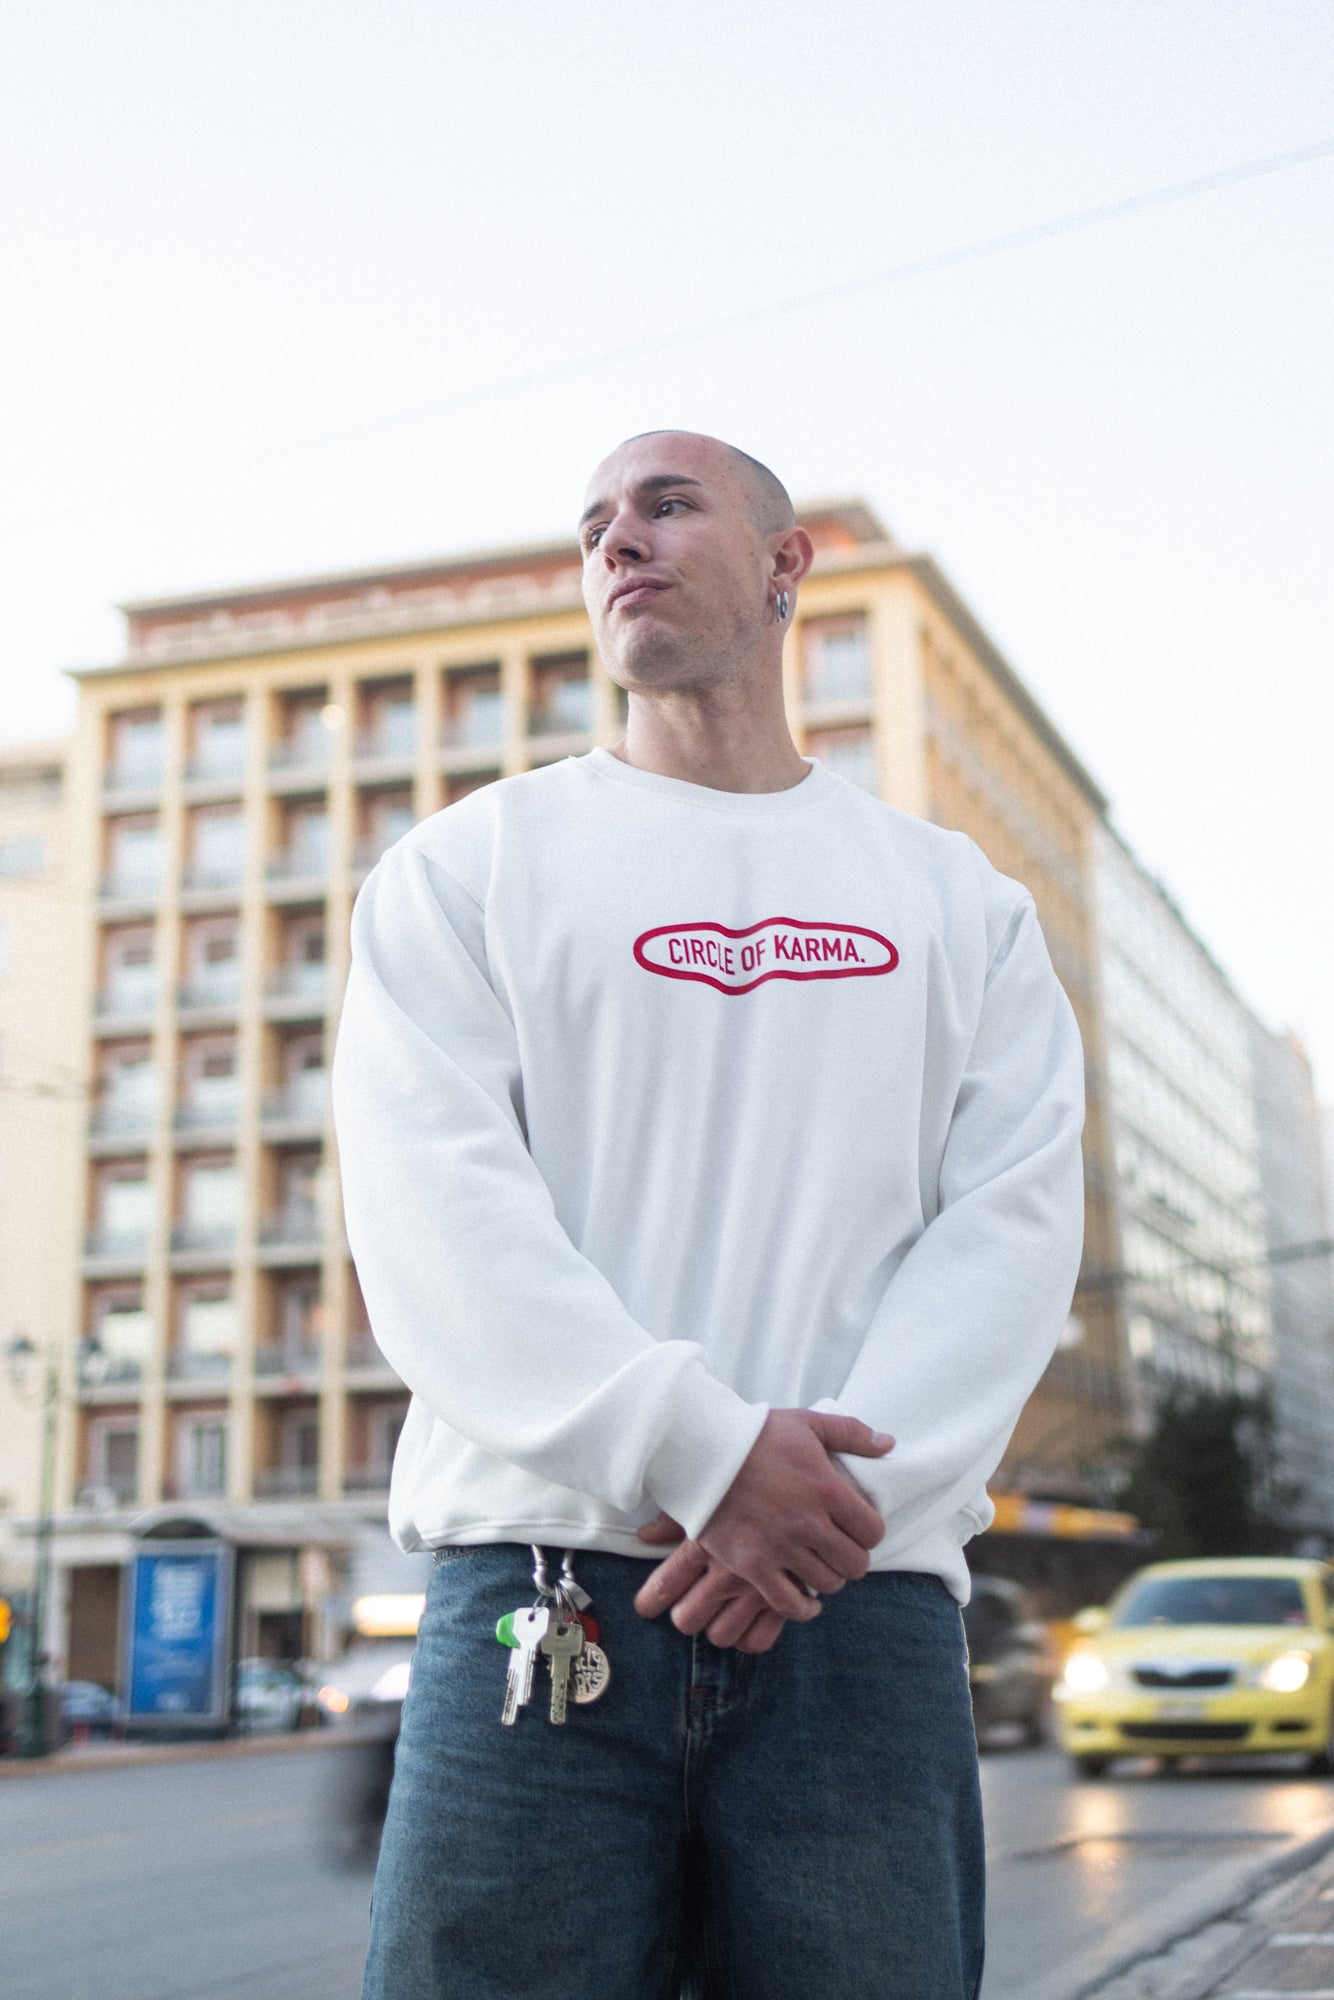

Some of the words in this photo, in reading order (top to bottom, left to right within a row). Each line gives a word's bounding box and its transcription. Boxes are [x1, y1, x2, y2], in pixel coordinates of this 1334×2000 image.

[668, 938, 735, 975] CIRCLE
[741, 939, 766, 972] OF
[774, 935, 865, 963] KARMA.
